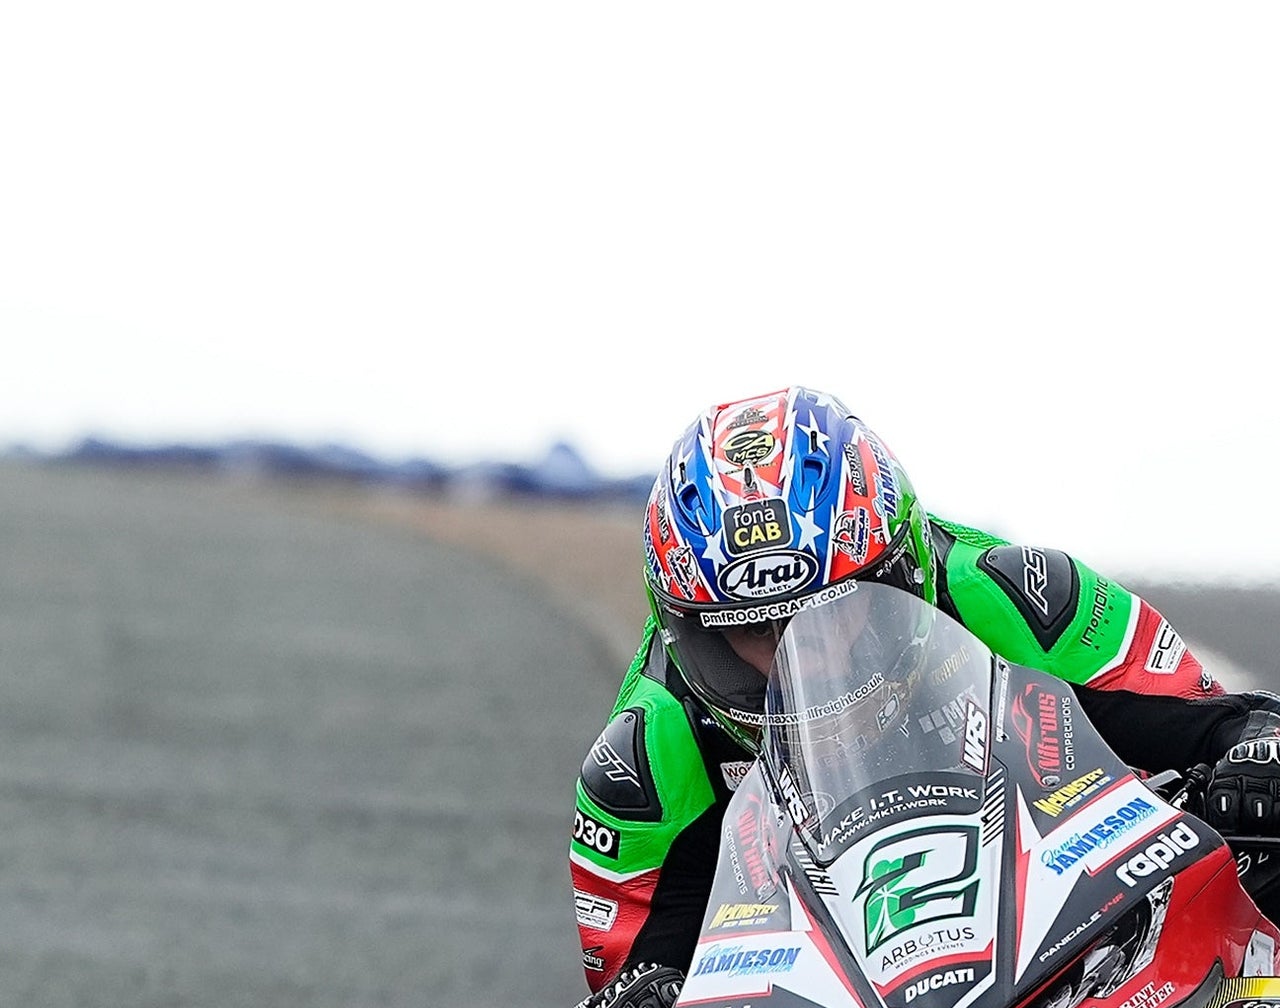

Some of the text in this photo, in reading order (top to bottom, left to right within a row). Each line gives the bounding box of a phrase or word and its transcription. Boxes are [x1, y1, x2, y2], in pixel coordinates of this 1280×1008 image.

[733, 508, 775, 527] fona
[734, 522, 782, 547] CAB
[728, 554, 806, 591] Arai
[1021, 545, 1049, 616] RS
[964, 703, 987, 771] WRS
[780, 768, 809, 825] WRS
[817, 785, 979, 855] MAKE I.T. WORK
[1045, 797, 1153, 875] JAMIESON
[1115, 822, 1200, 887] rapid
[852, 825, 980, 957] 2
[693, 948, 801, 977] JAMIESON
[905, 968, 974, 1003] DUCATI
